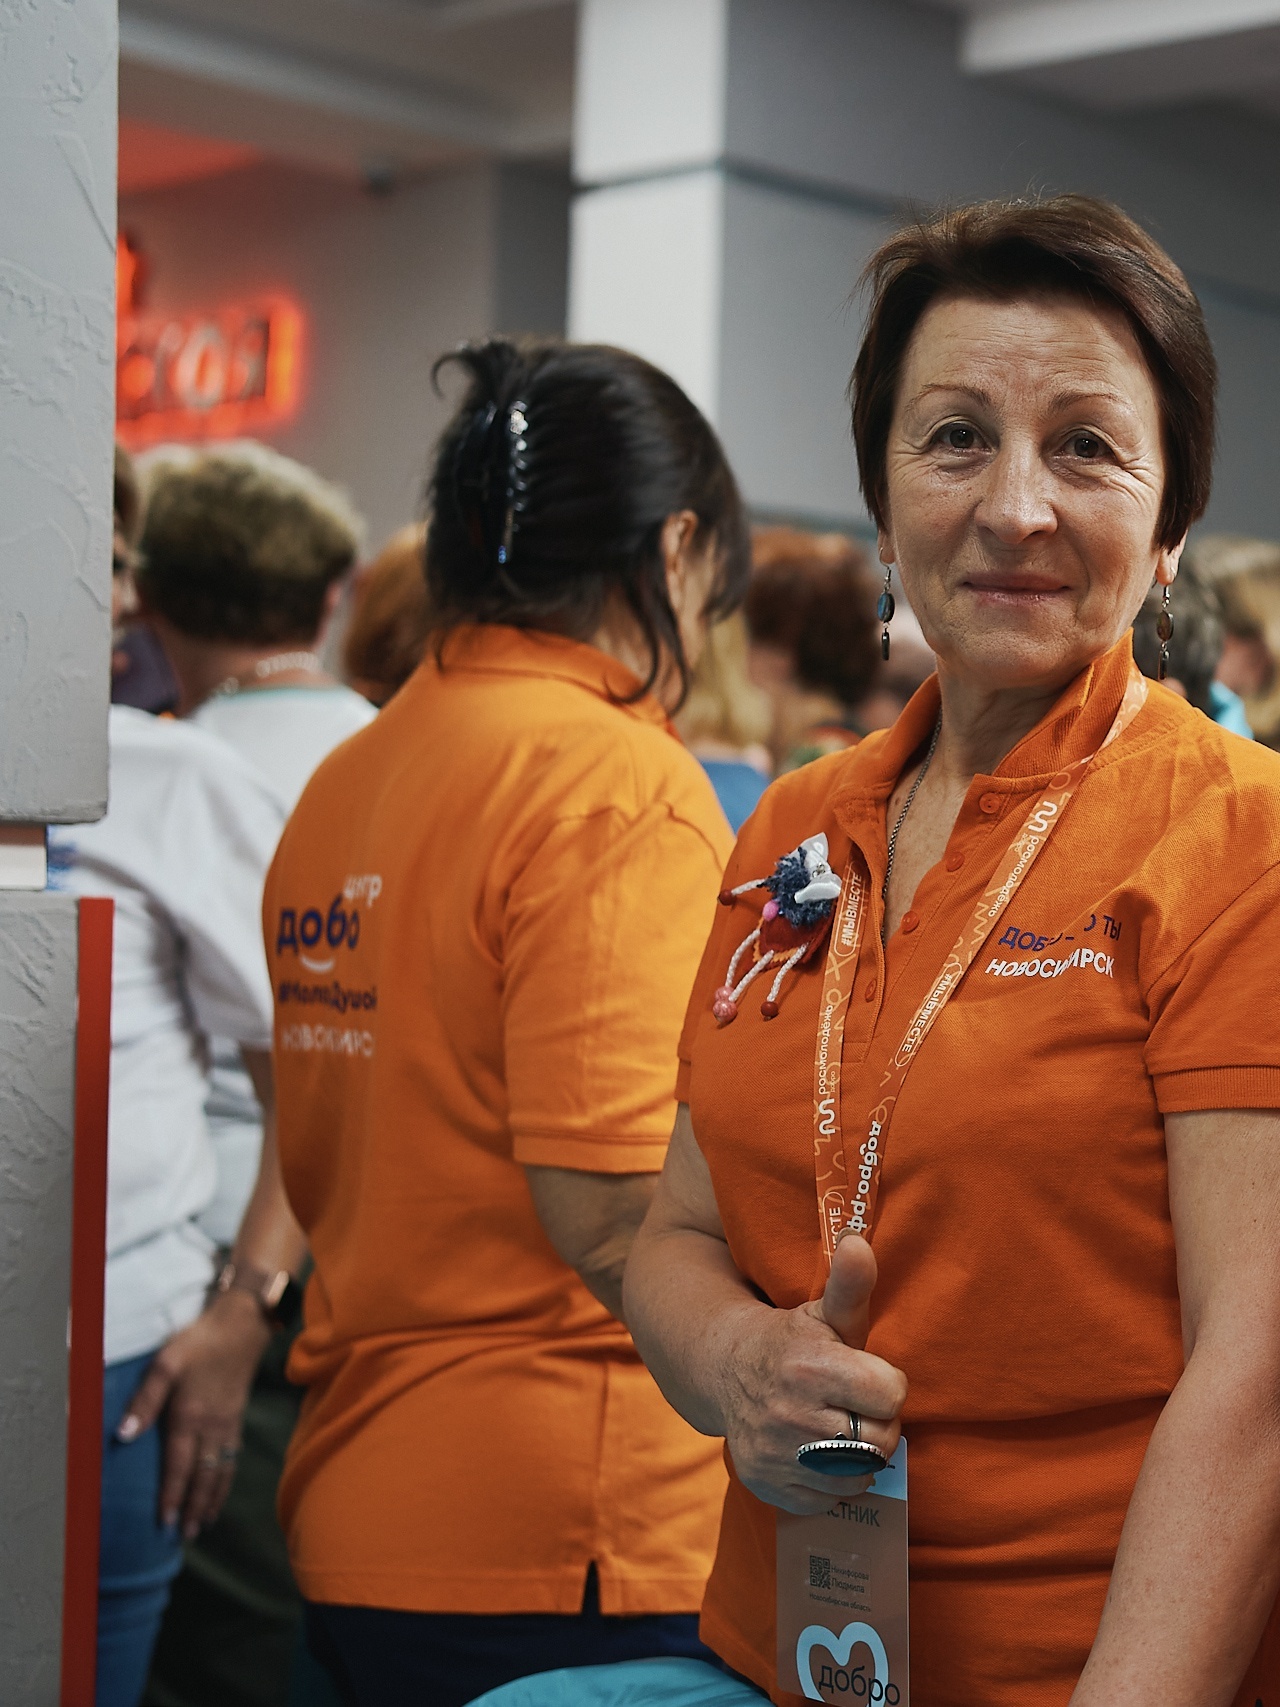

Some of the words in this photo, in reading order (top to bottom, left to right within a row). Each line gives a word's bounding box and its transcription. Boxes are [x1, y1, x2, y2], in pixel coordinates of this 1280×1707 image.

[842, 873, 862, 946] #МЫВМЕСТЕ
[988, 834, 1039, 917] росмолодёжь
[985, 948, 1115, 978] НОВОСИИРСК
[998, 926, 1063, 952] ДОБ
[901, 973, 952, 1053] #МЫВМЕСТЕ
[818, 1005, 834, 1096] росмолодёжь
[846, 1120, 882, 1233] добро.рф
[827, 1502, 880, 1527] СТНИК
[819, 1665, 900, 1707] добро
